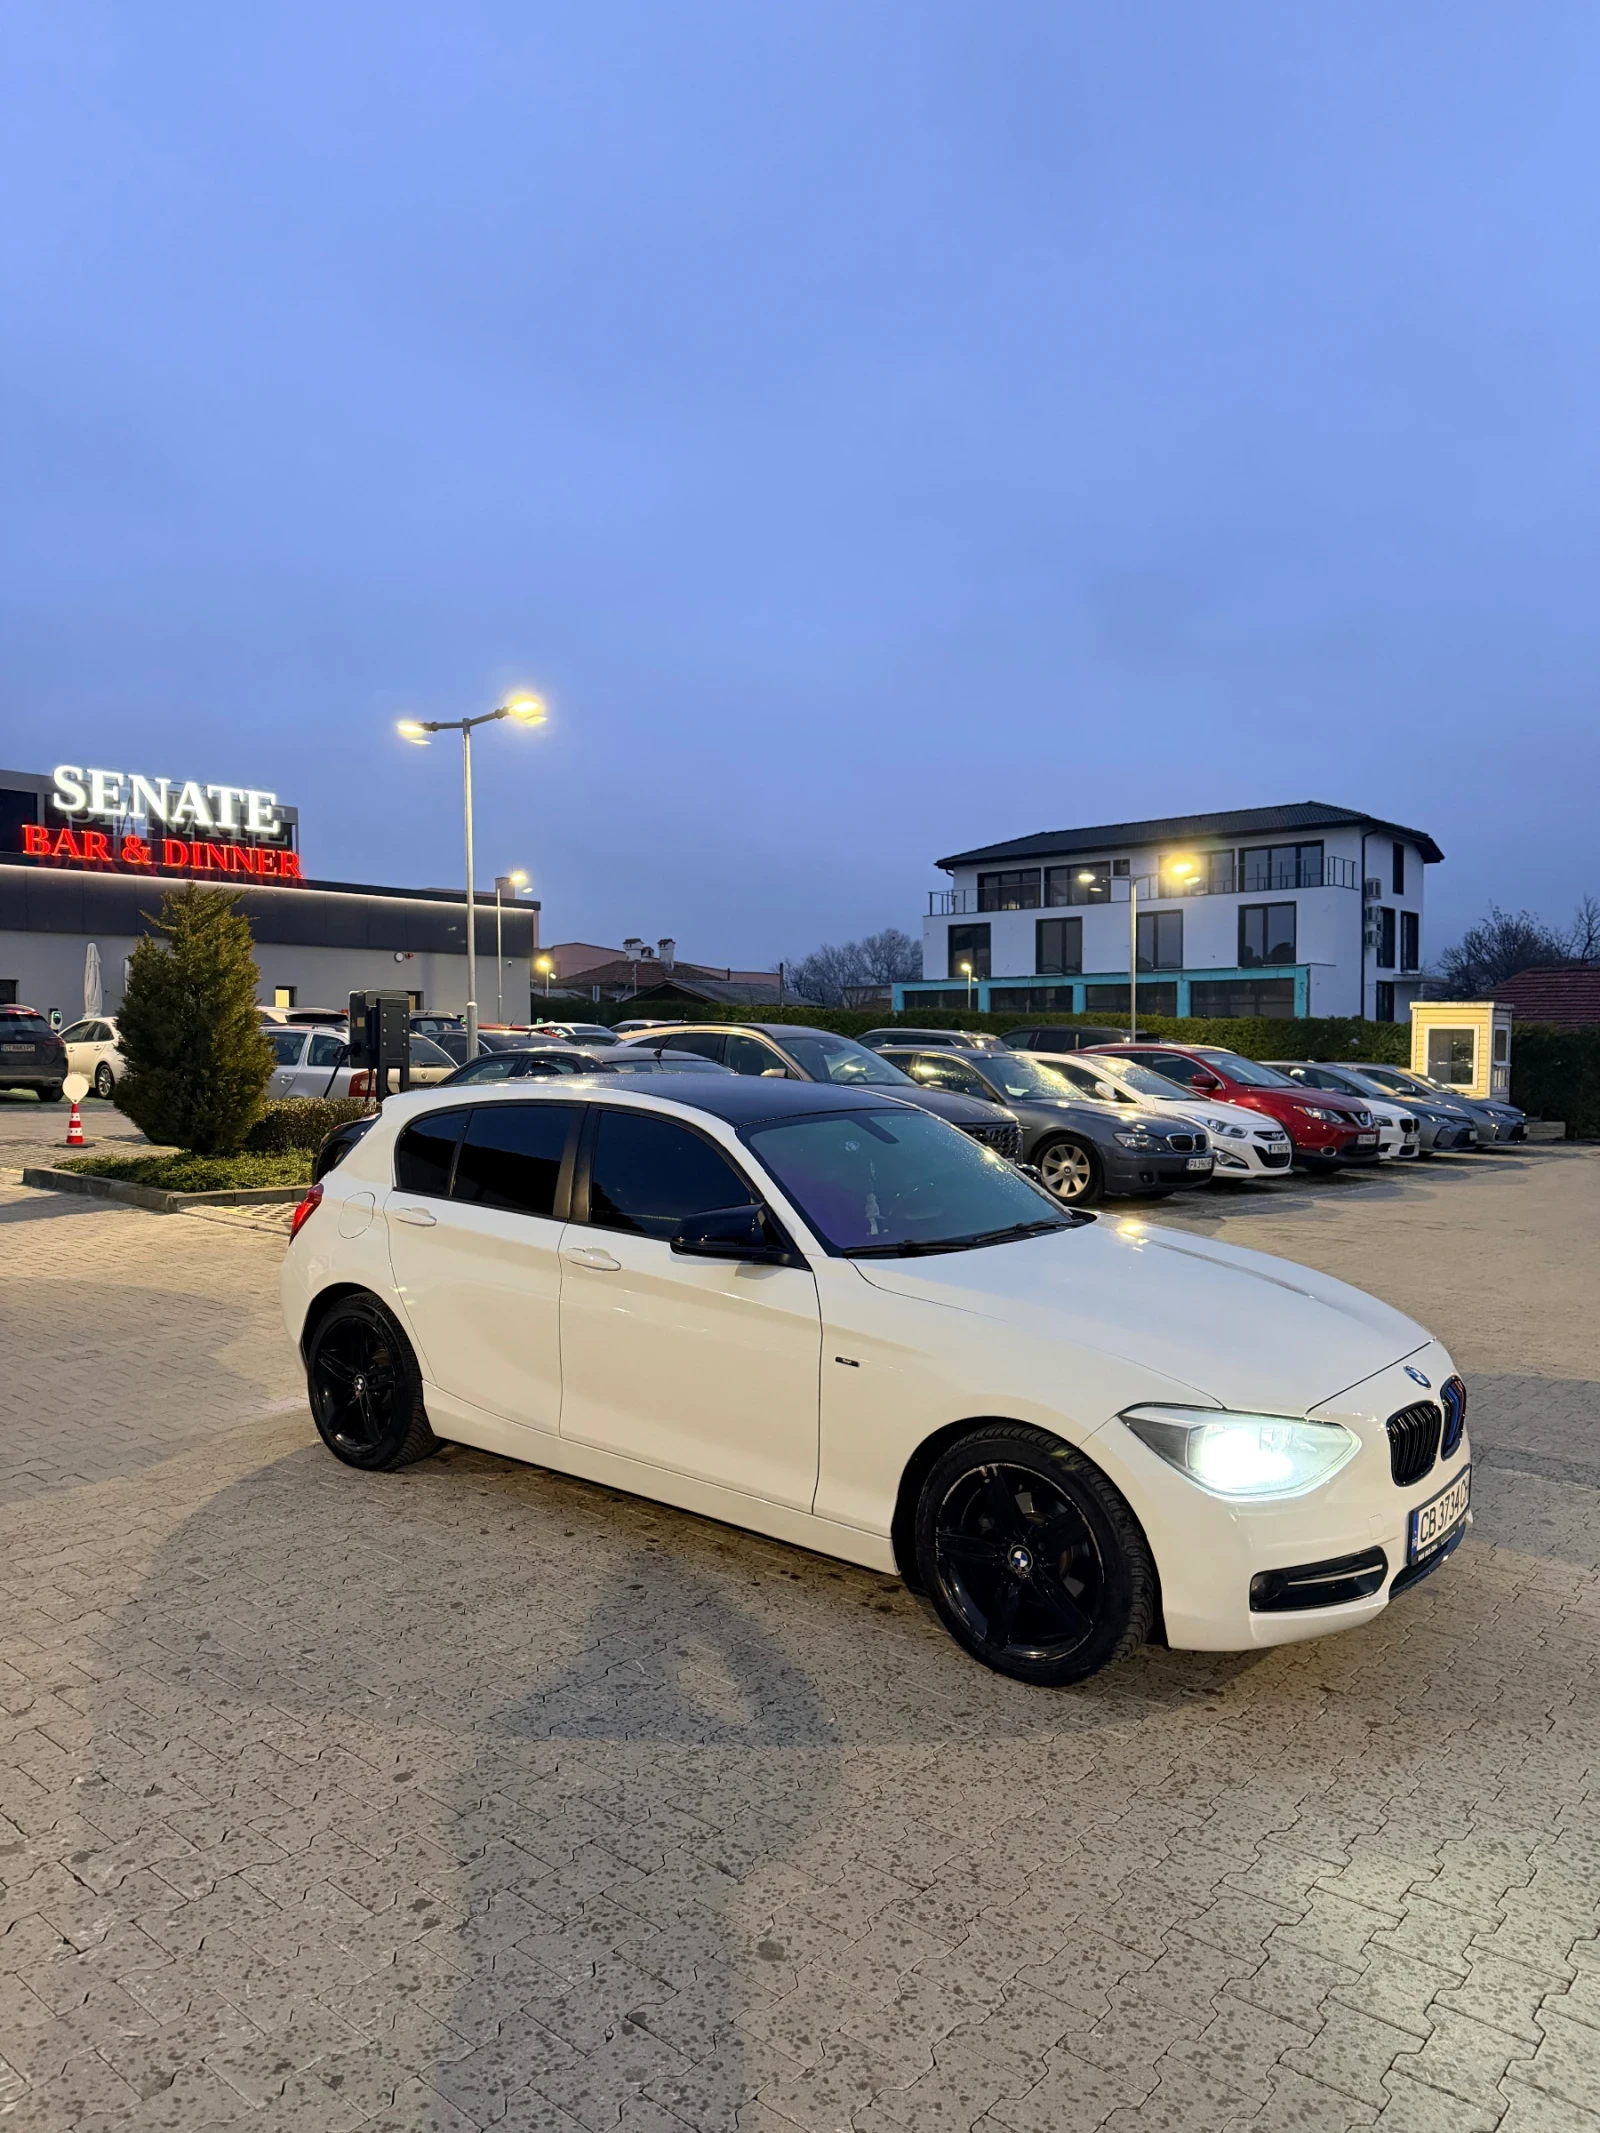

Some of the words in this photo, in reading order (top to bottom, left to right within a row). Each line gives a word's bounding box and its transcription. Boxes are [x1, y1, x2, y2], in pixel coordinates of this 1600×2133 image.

[53, 765, 280, 834] SENATE
[21, 824, 112, 862] BAR
[121, 834, 152, 865] &
[161, 838, 304, 879] DINNER
[1421, 1507, 1436, 1542] CB
[1438, 1485, 1460, 1530] 3734
